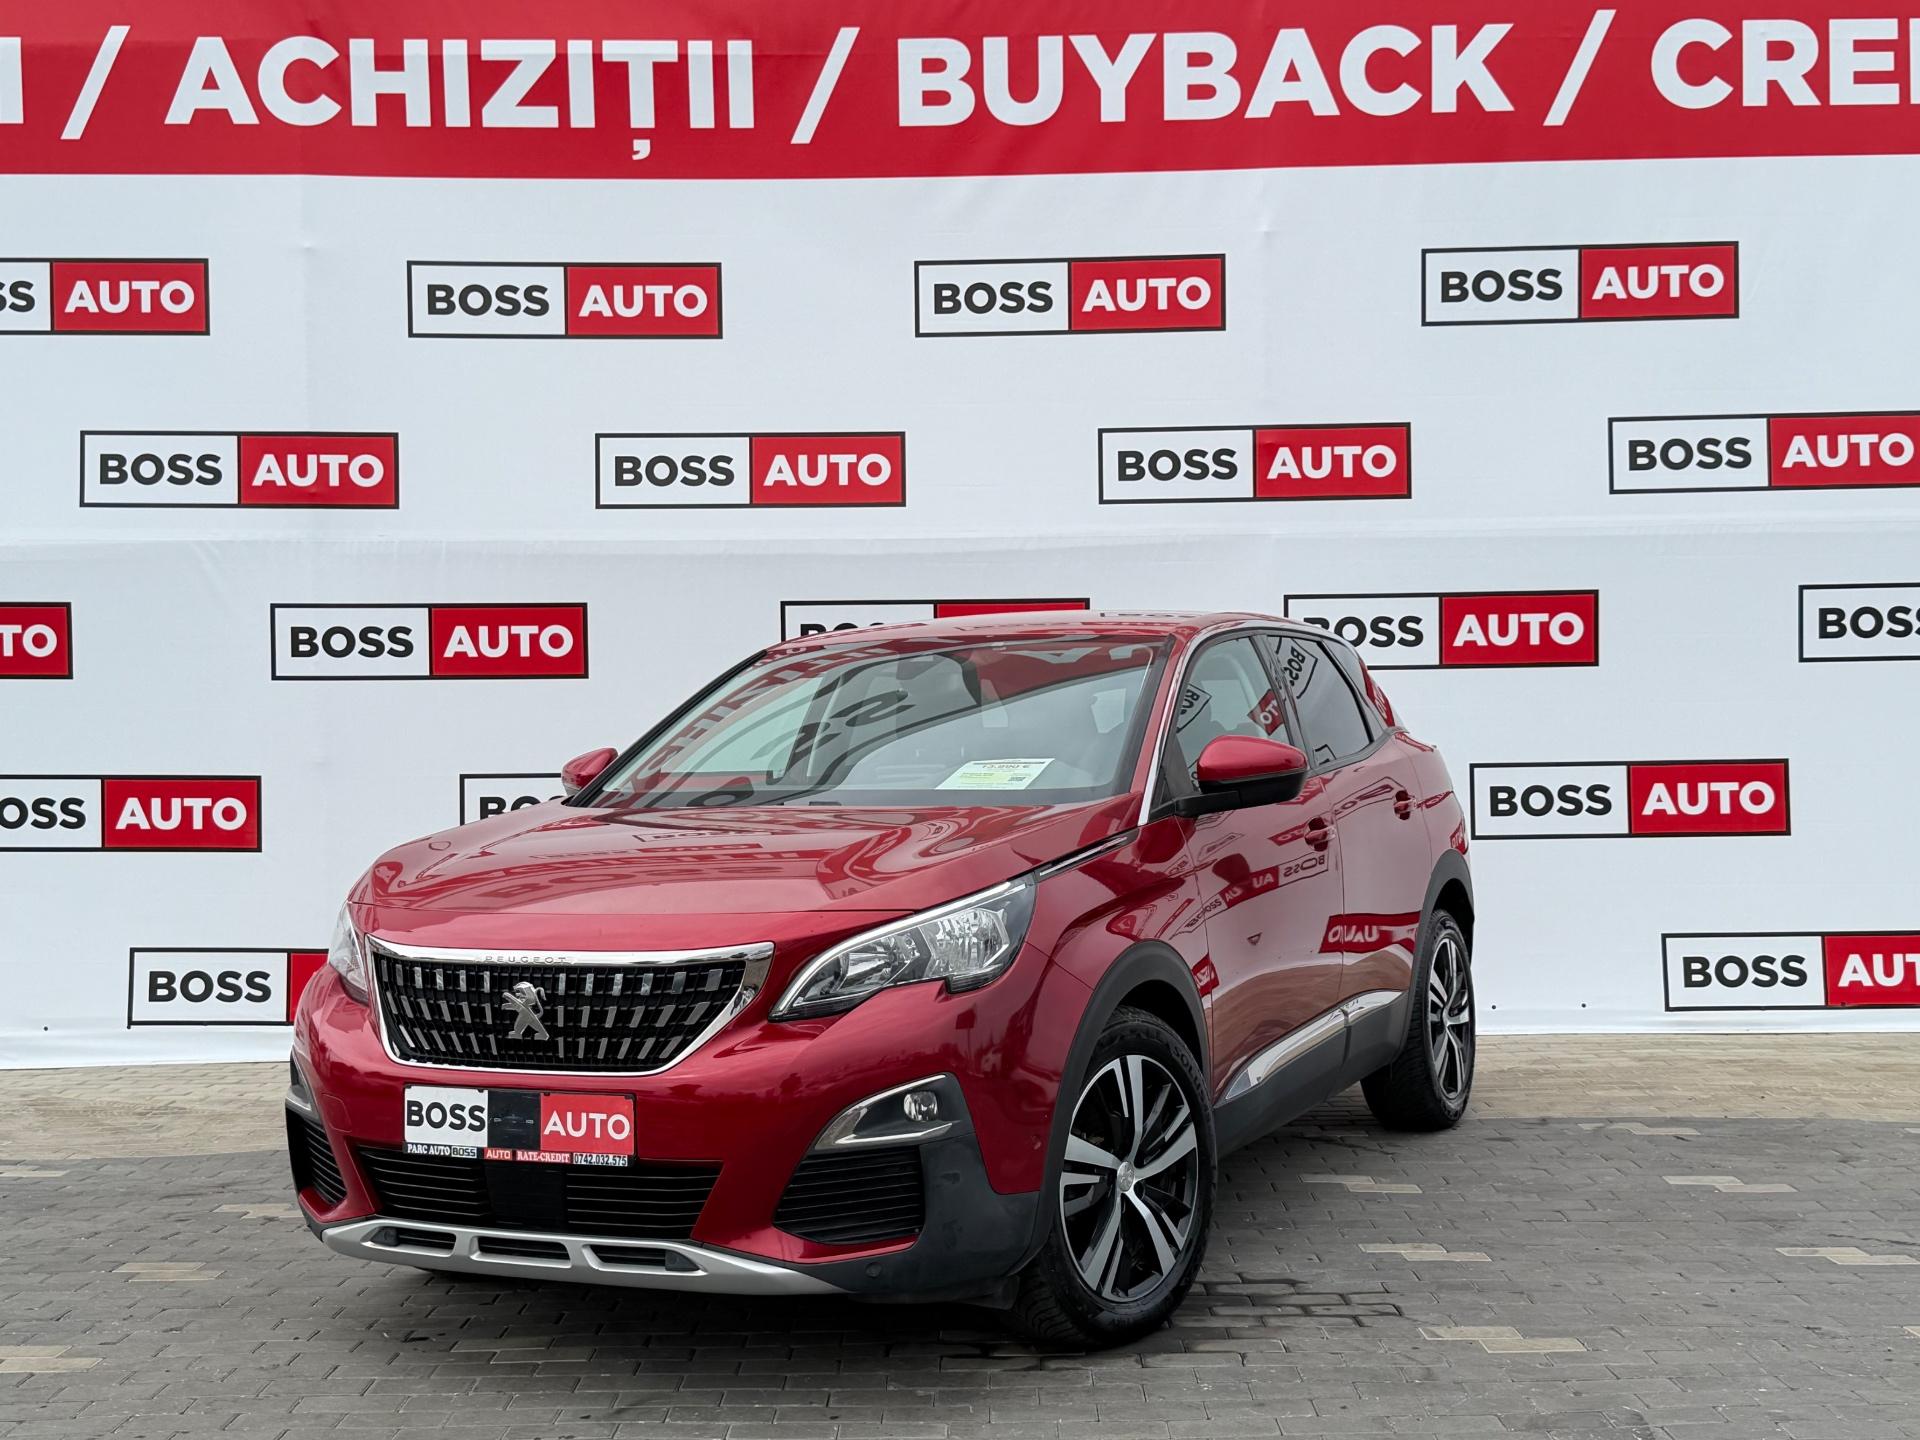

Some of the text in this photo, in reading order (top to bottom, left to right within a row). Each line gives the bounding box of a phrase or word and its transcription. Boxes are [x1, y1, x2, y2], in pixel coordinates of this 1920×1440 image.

[165, 36, 754, 160] ACHIZIȚII
[898, 24, 1514, 126] BUYBACK
[1651, 18, 1920, 109] CRE
[0, 281, 194, 313] S AUTO
[934, 277, 1211, 314] BOSS AUTO
[1442, 264, 1724, 302] BOSS AUTO
[428, 285, 707, 317] BOSS AUTO
[1118, 445, 1396, 481] BOSS AUTO
[1629, 433, 1914, 470] BOSS AUTO
[100, 454, 383, 487] BOSS AUTO
[615, 454, 891, 486] BOSS AUTO
[1453, 613, 1583, 646] AUTO
[1819, 606, 1920, 638] BOS
[0, 625, 57, 657] TO
[291, 625, 573, 657] BOSS AUTO
[0, 798, 246, 830] OSS AUTO
[1490, 781, 1774, 816] BOSS AUTO
[485, 955, 566, 964] PEUGEOT
[1683, 955, 1807, 987] BOSS
[149, 971, 271, 1002] BOSS
[407, 1100, 630, 1140] BOSS AUTO
[407, 1143, 627, 1166] PARC AUTO BOSS AUTO RATE-CREDIT 0742.032.575
